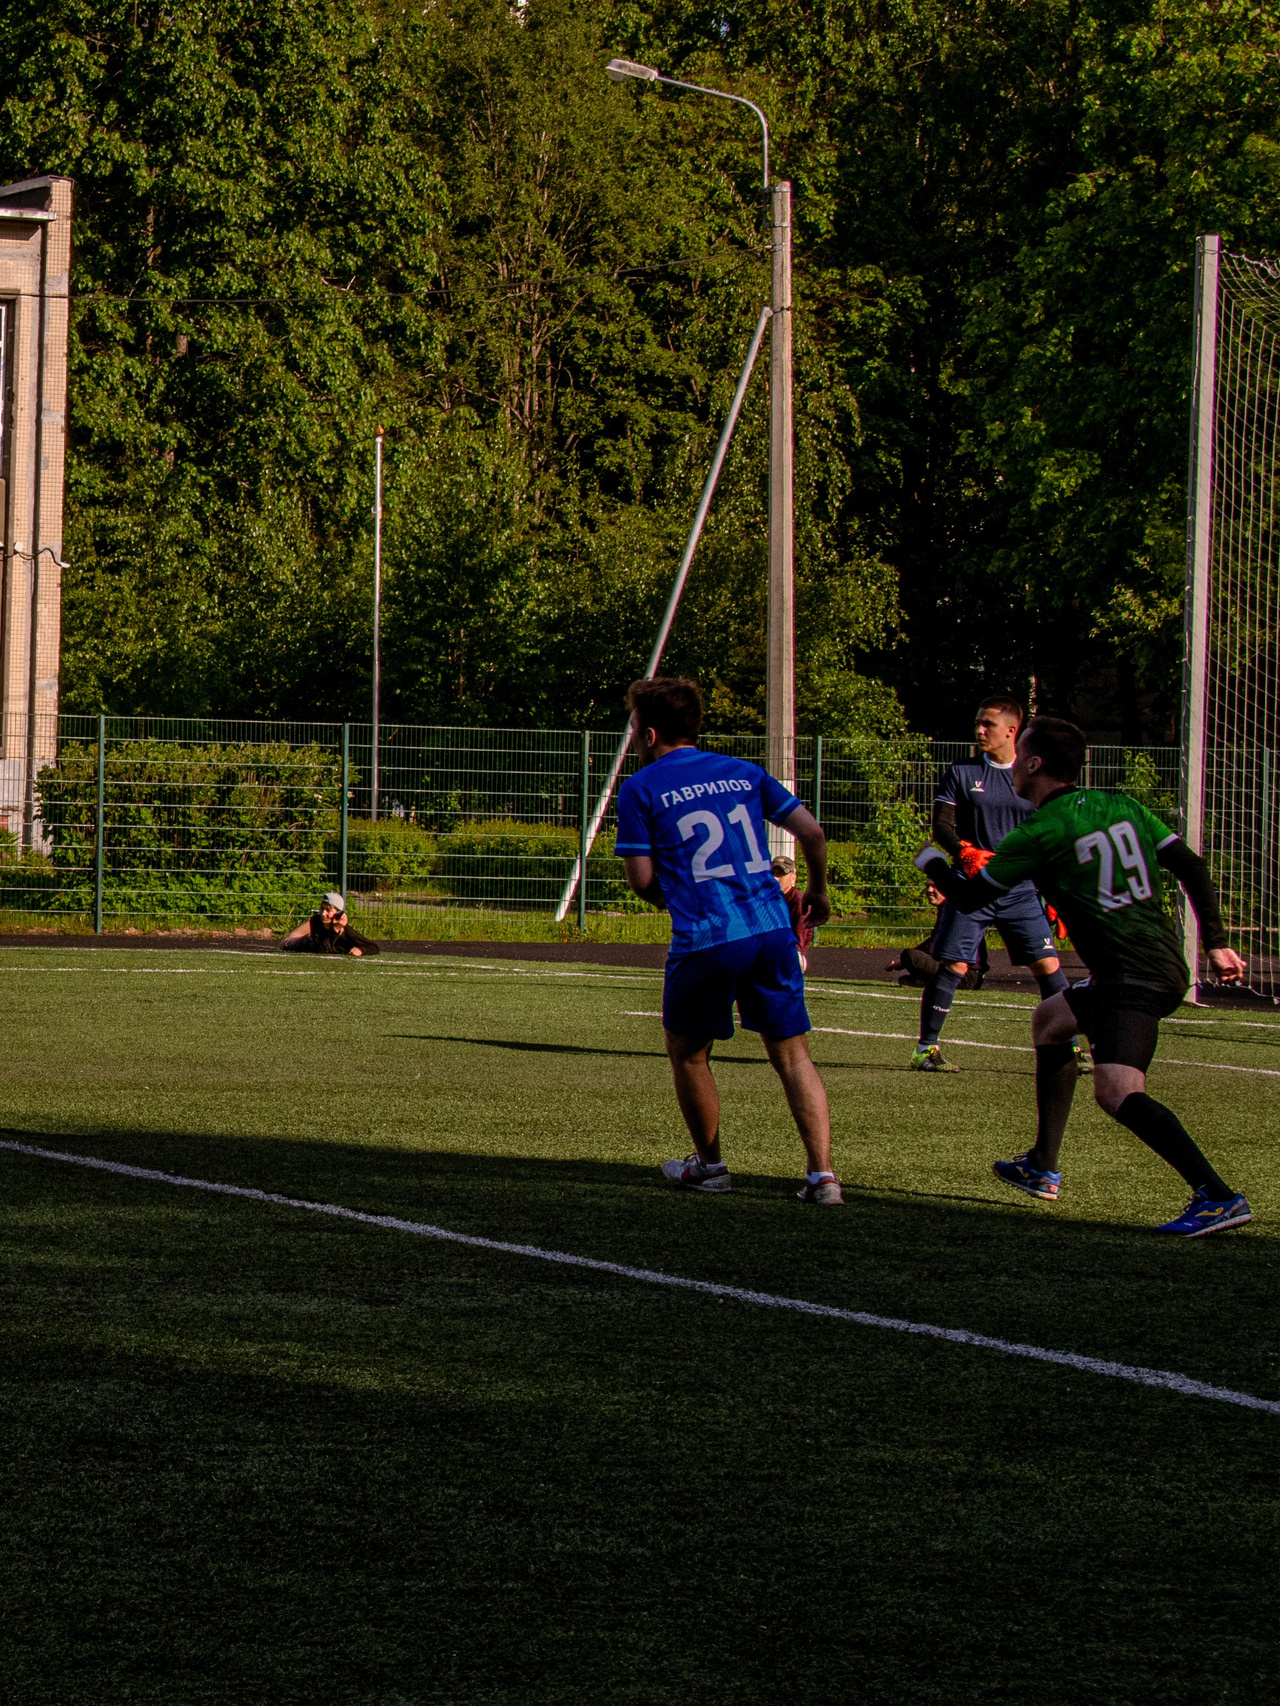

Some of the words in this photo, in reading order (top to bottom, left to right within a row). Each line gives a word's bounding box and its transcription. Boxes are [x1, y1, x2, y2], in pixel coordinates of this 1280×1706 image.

[661, 780, 752, 808] ГАВРИЛОВ
[676, 804, 771, 883] 21
[1074, 820, 1153, 912] 29
